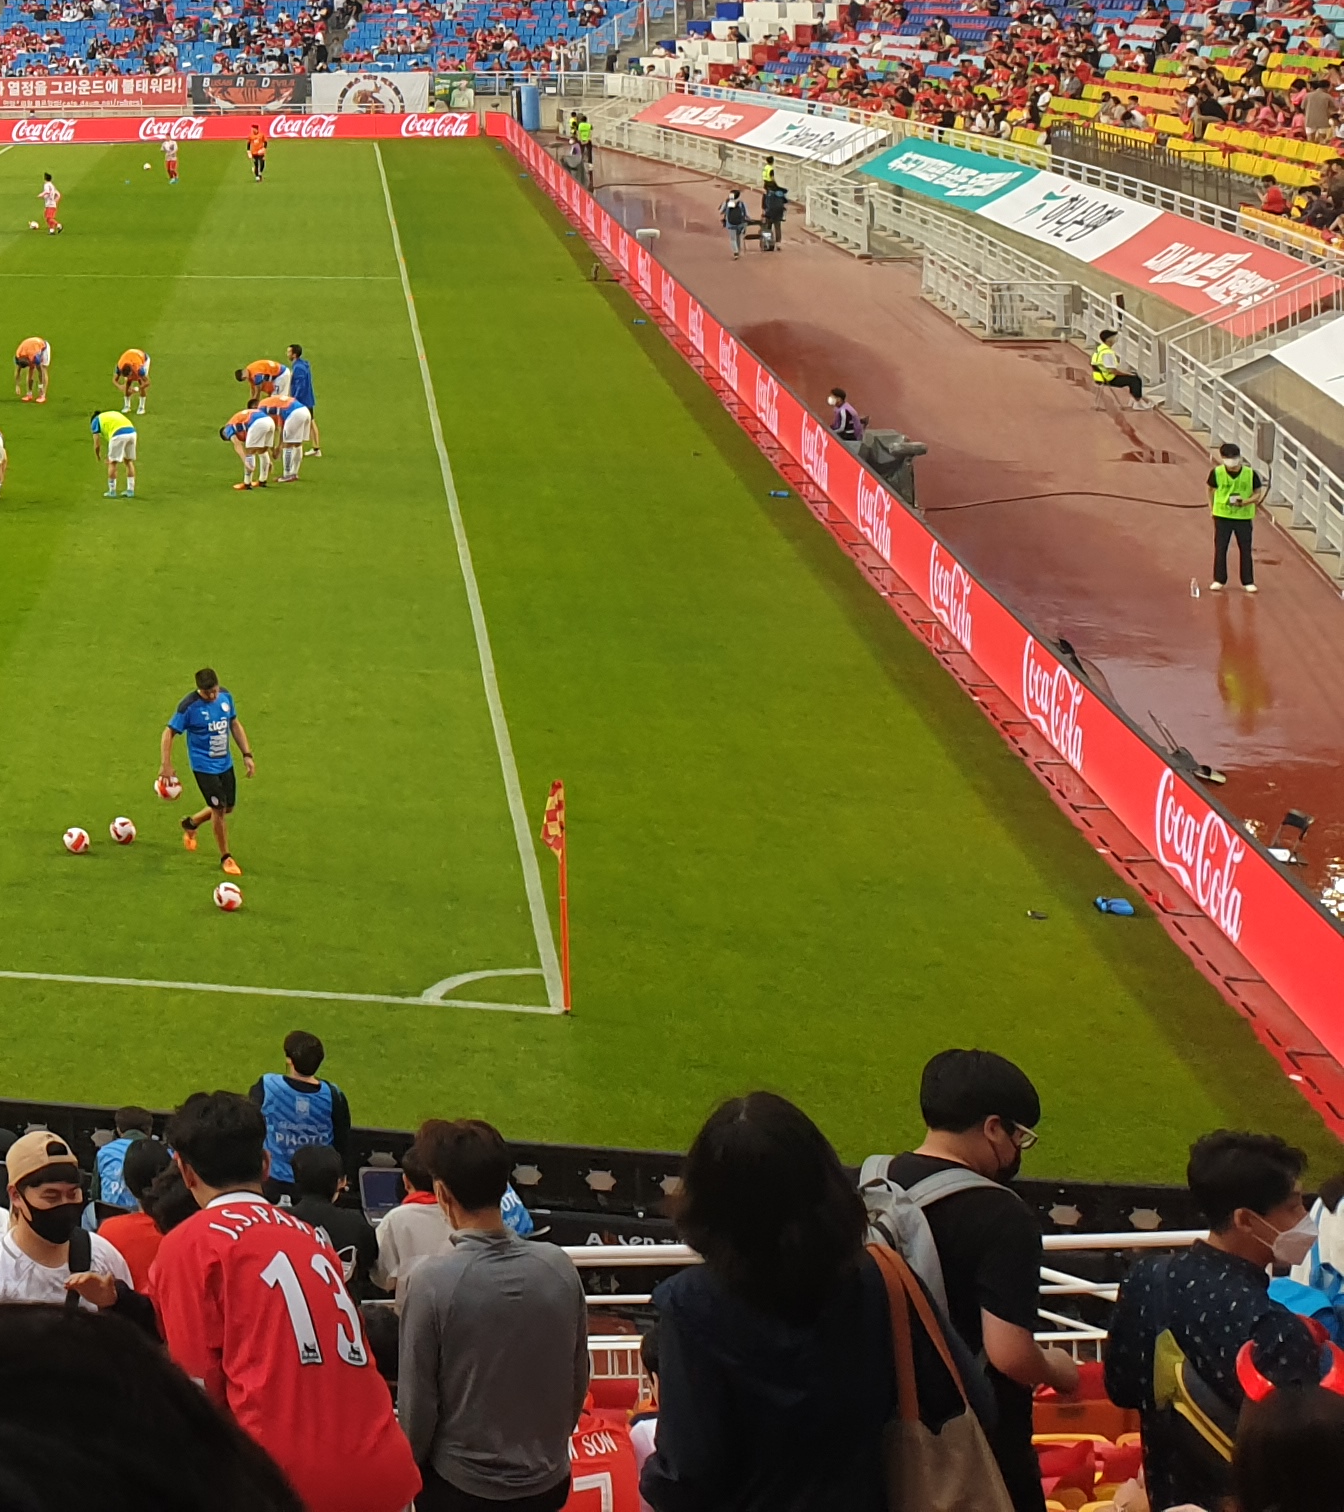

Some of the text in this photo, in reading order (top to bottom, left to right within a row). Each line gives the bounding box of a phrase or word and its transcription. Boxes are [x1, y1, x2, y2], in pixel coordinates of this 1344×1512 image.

[7, 80, 47, 96] 열정을
[49, 78, 118, 96] 그라운드에
[122, 77, 182, 95] 불태워라!
[12, 119, 77, 142] Coca-Cola
[269, 114, 338, 138] Coca-Cola
[401, 112, 472, 137] Coca-Cola
[1036, 193, 1125, 242] 하나은행
[857, 467, 891, 563] Coca-Cola
[929, 540, 973, 653] Coca-Cola
[1022, 635, 1083, 772] Coca-Cola
[1155, 767, 1245, 943] Coca-Cola
[260, 1251, 367, 1365] 13
[582, 1430, 618, 1457] SON
[573, 1472, 613, 1512] 7
